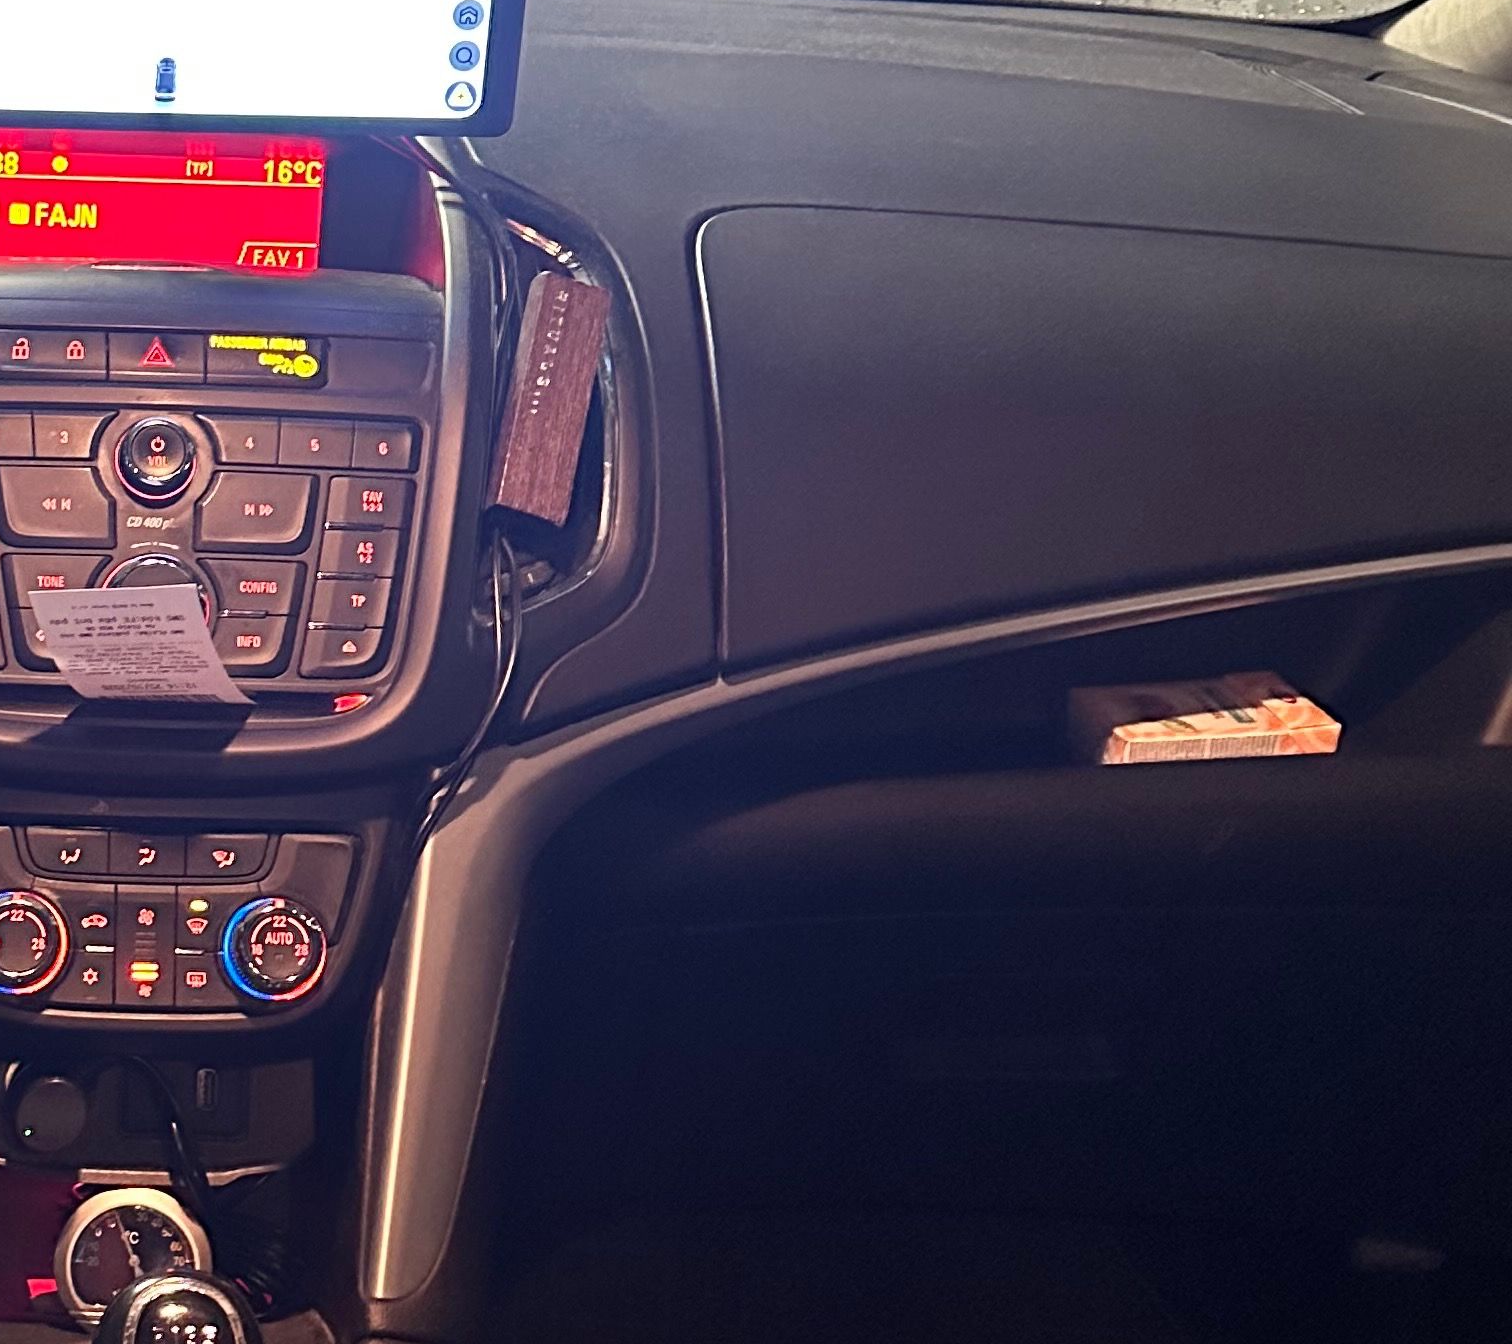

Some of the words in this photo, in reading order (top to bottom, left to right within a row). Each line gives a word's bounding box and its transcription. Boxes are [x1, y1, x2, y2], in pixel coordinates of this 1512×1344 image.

[264, 160, 322, 184] 16°C
[35, 202, 98, 228] FAJN
[253, 249, 290, 267] FAV
[296, 250, 304, 269] 1
[60, 430, 69, 443] 3
[245, 436, 254, 449] 4
[310, 438, 320, 451] 5
[378, 442, 388, 455] 6
[148, 455, 168, 467] VOL
[362, 490, 383, 502] FAV
[356, 541, 374, 555] AS
[37, 575, 65, 588] TONE
[239, 581, 277, 594] CONFIG
[350, 594, 366, 607] TP
[236, 636, 261, 648] INFO
[9, 909, 24, 922] 22
[273, 916, 287, 928] 22
[31, 937, 45, 951] 28
[264, 932, 294, 945] AUTO
[295, 944, 309, 957] 28
[173, 1255, 186, 1266] 70
